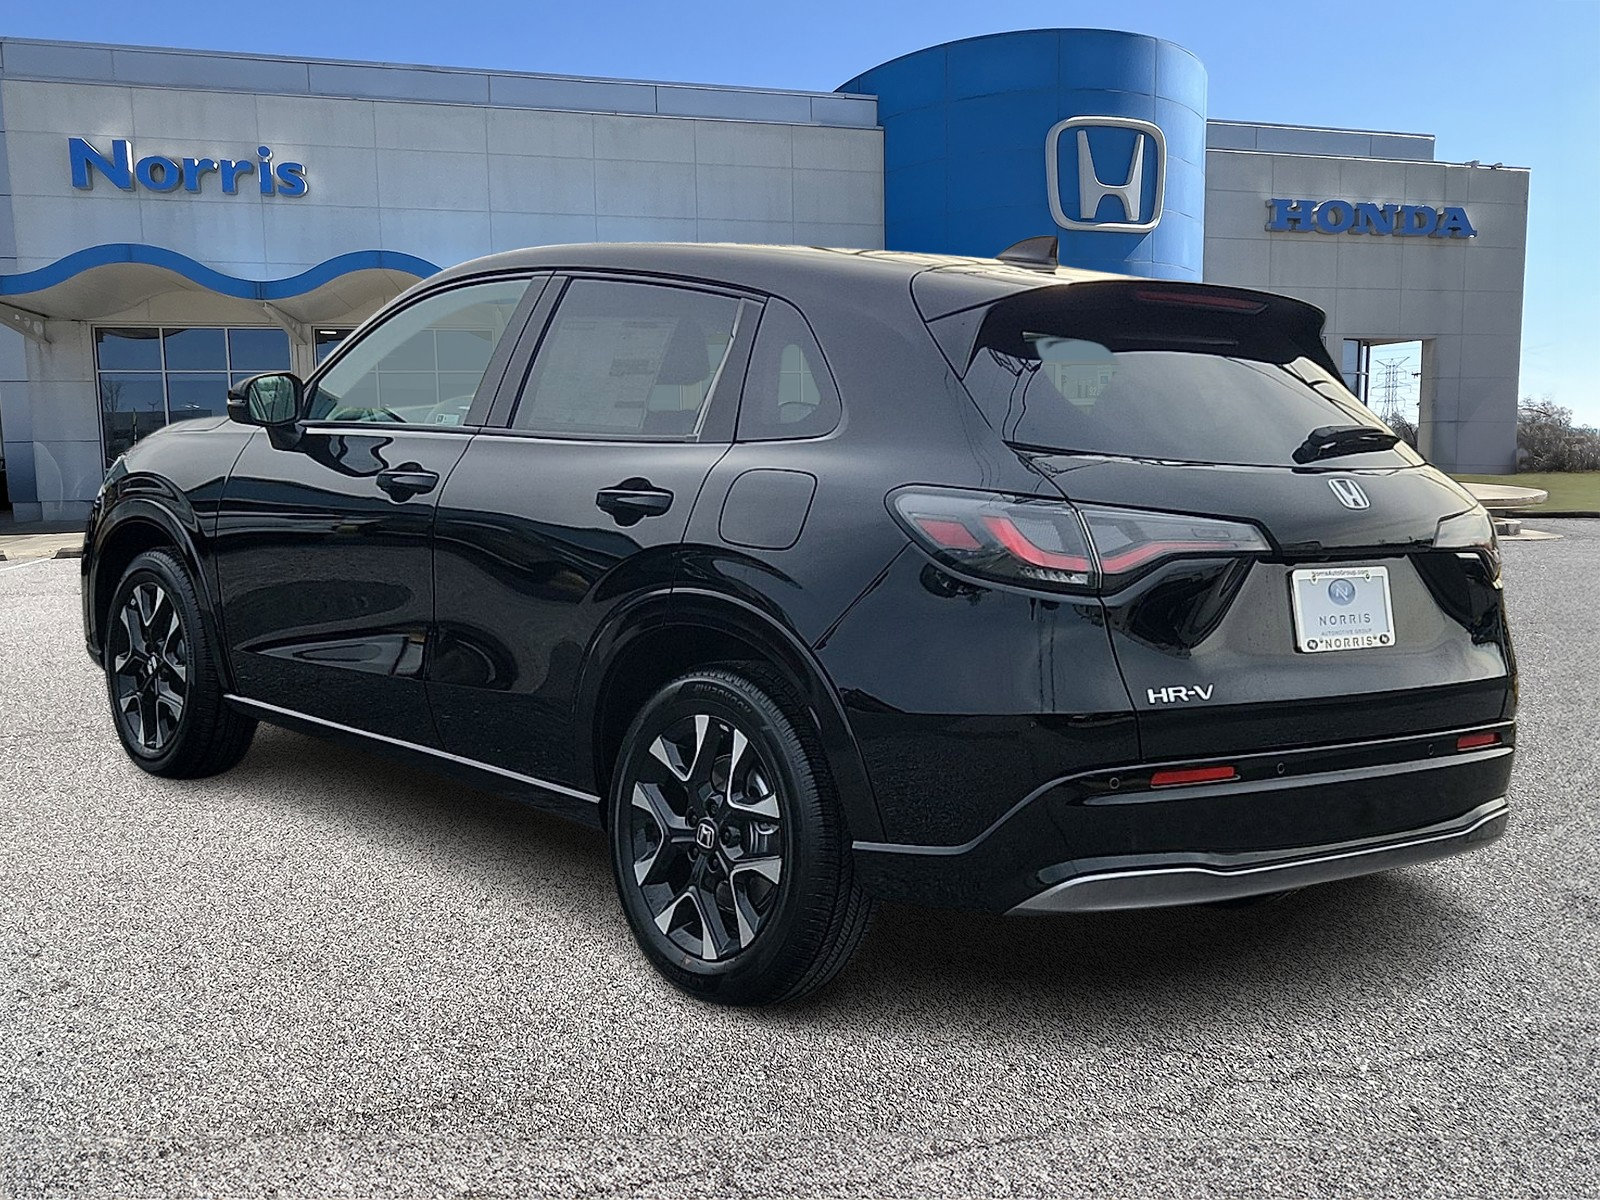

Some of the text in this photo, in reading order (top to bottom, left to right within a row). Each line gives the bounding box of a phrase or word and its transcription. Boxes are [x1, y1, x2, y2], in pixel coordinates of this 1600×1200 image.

[68, 137, 308, 196] Norris
[1265, 198, 1477, 239] HONDA
[1319, 613, 1371, 626] NORRIS
[1325, 636, 1373, 649] NORRIS
[1147, 684, 1213, 703] HR-V
